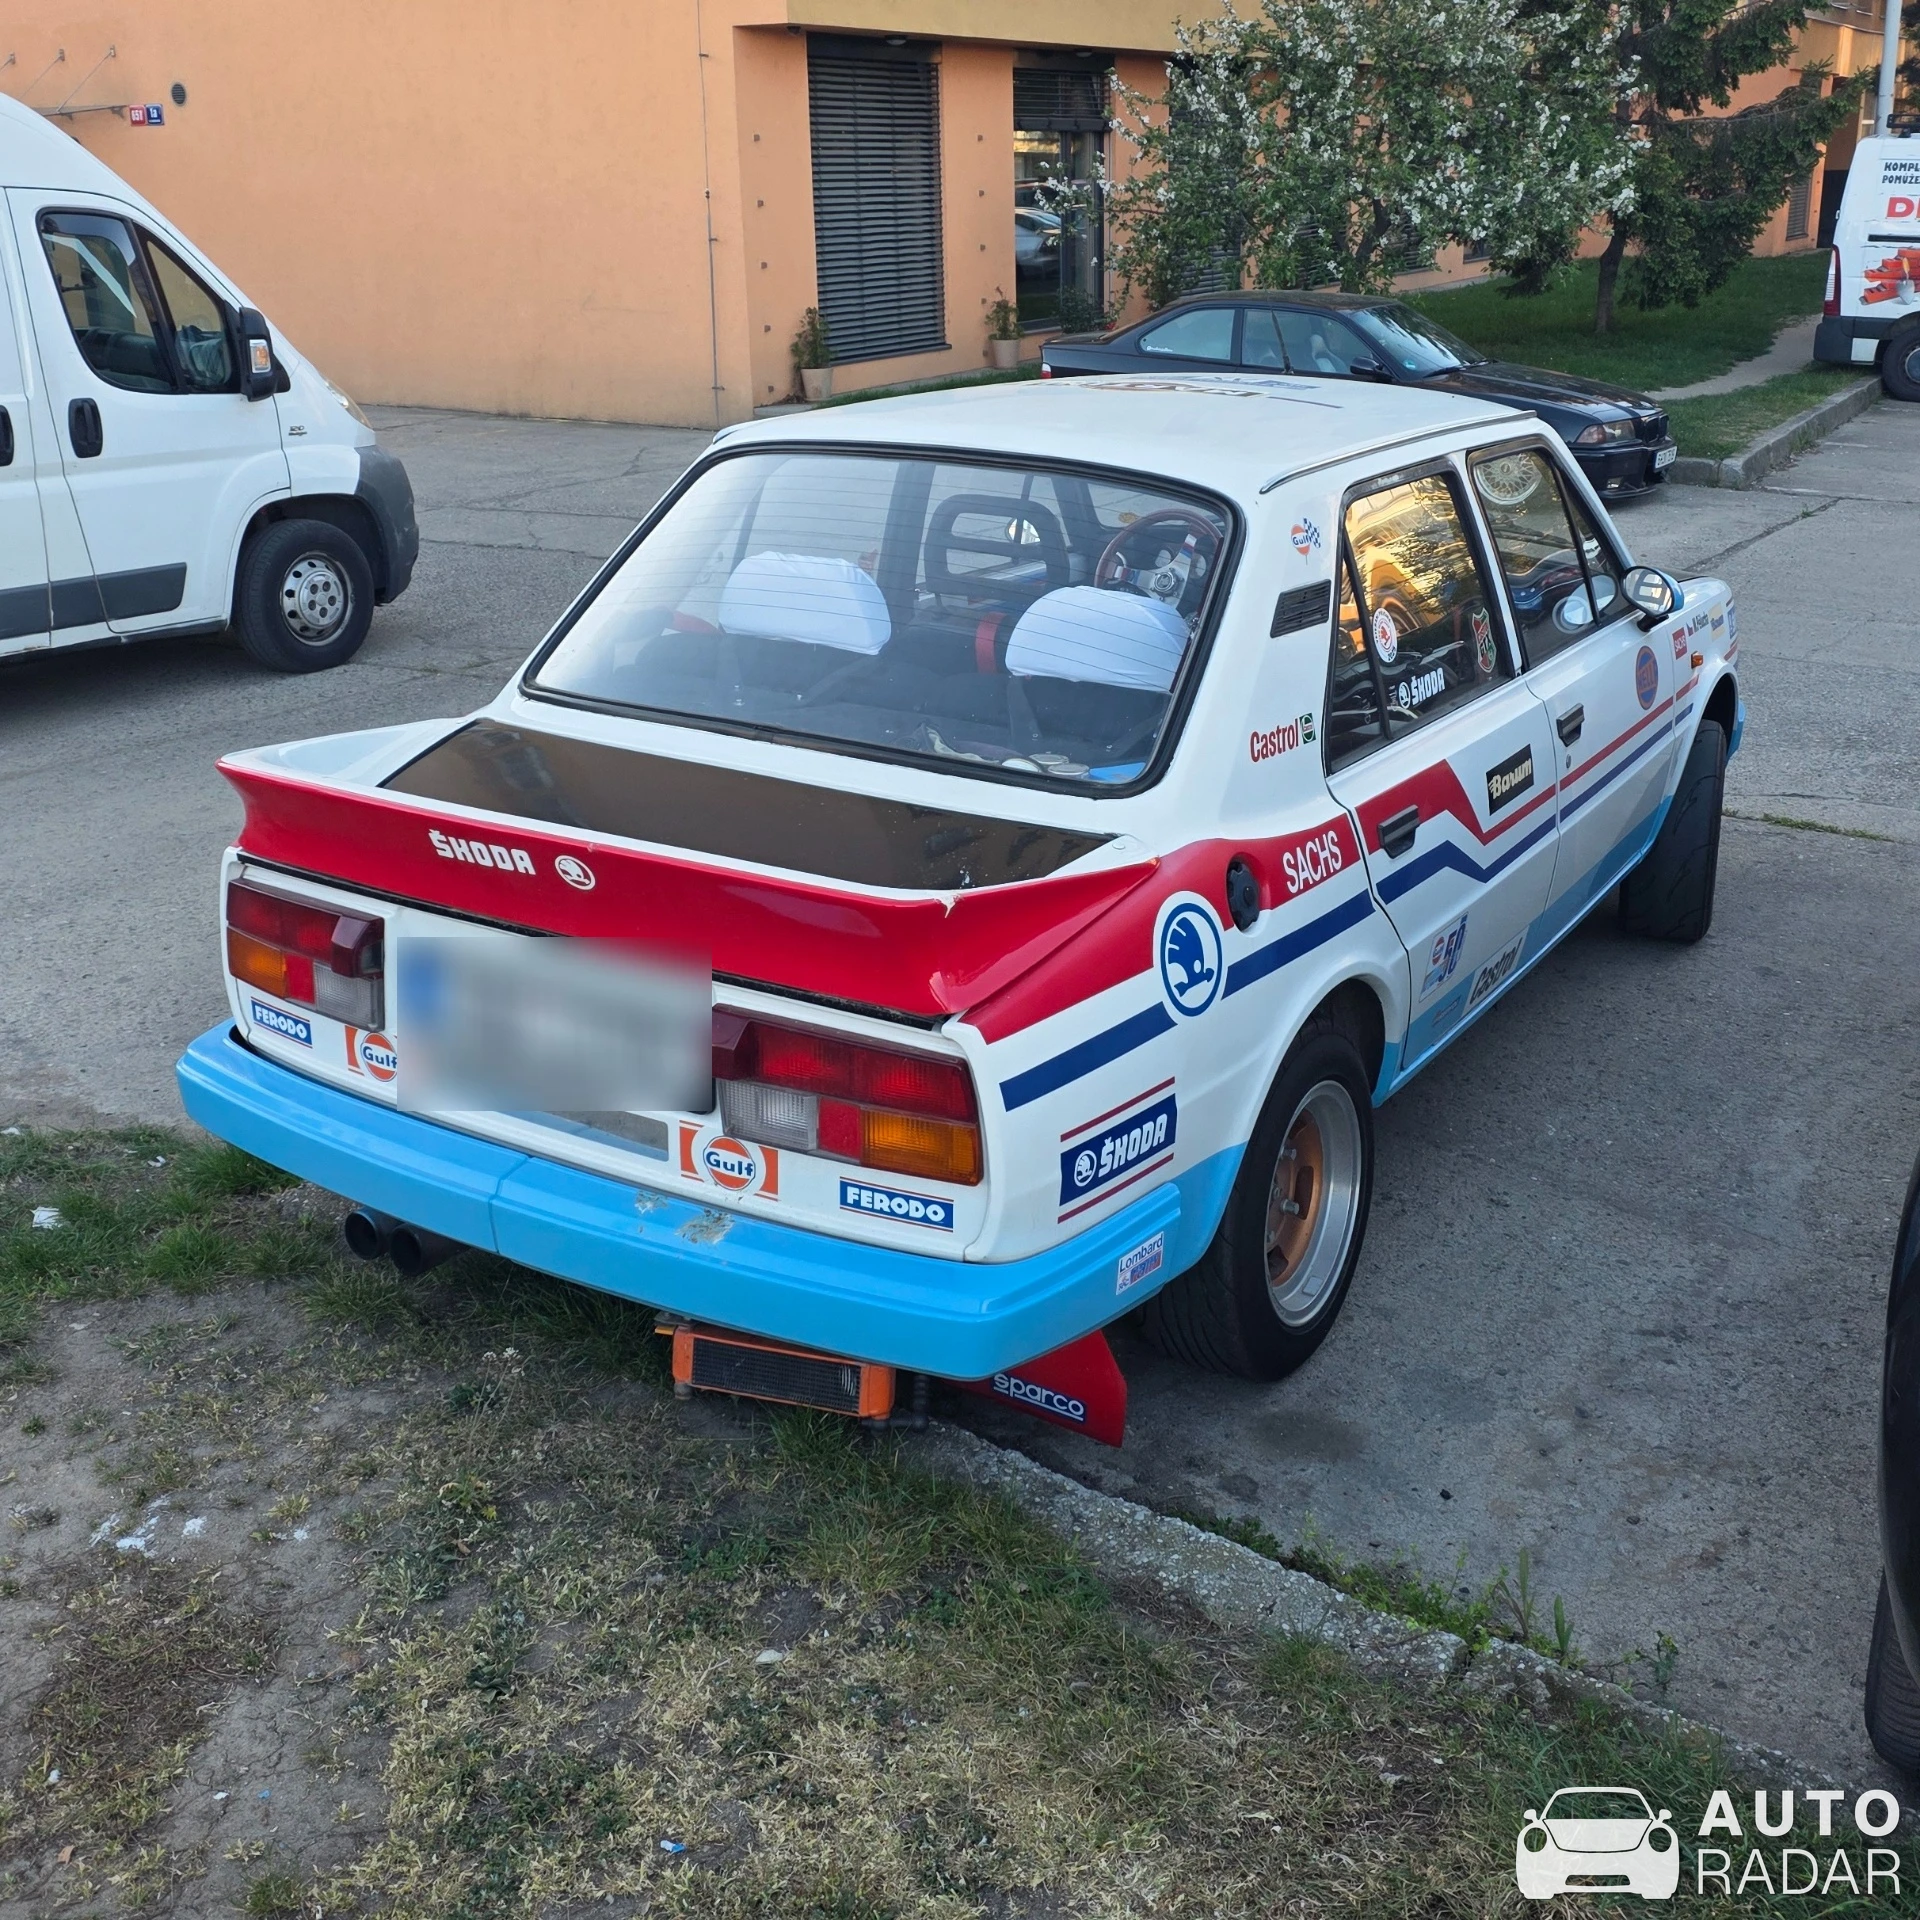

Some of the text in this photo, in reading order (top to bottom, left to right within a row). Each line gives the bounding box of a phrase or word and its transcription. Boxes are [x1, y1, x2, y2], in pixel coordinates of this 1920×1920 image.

[1886, 197, 1920, 218] D
[1410, 667, 1446, 706] ŠKODA
[1250, 717, 1299, 763] Castrol
[1488, 757, 1532, 800] Barum
[428, 828, 537, 876] ŠKODA
[1282, 830, 1342, 894] SACHS
[254, 1005, 308, 1039] FERODO
[362, 1045, 398, 1069] Gulf
[706, 1151, 754, 1177] Gulf
[1098, 1113, 1168, 1178] ŠKODA
[846, 1186, 946, 1222] FERODO
[1120, 1233, 1163, 1273] Lombard
[993, 1373, 1085, 1416] sparco
